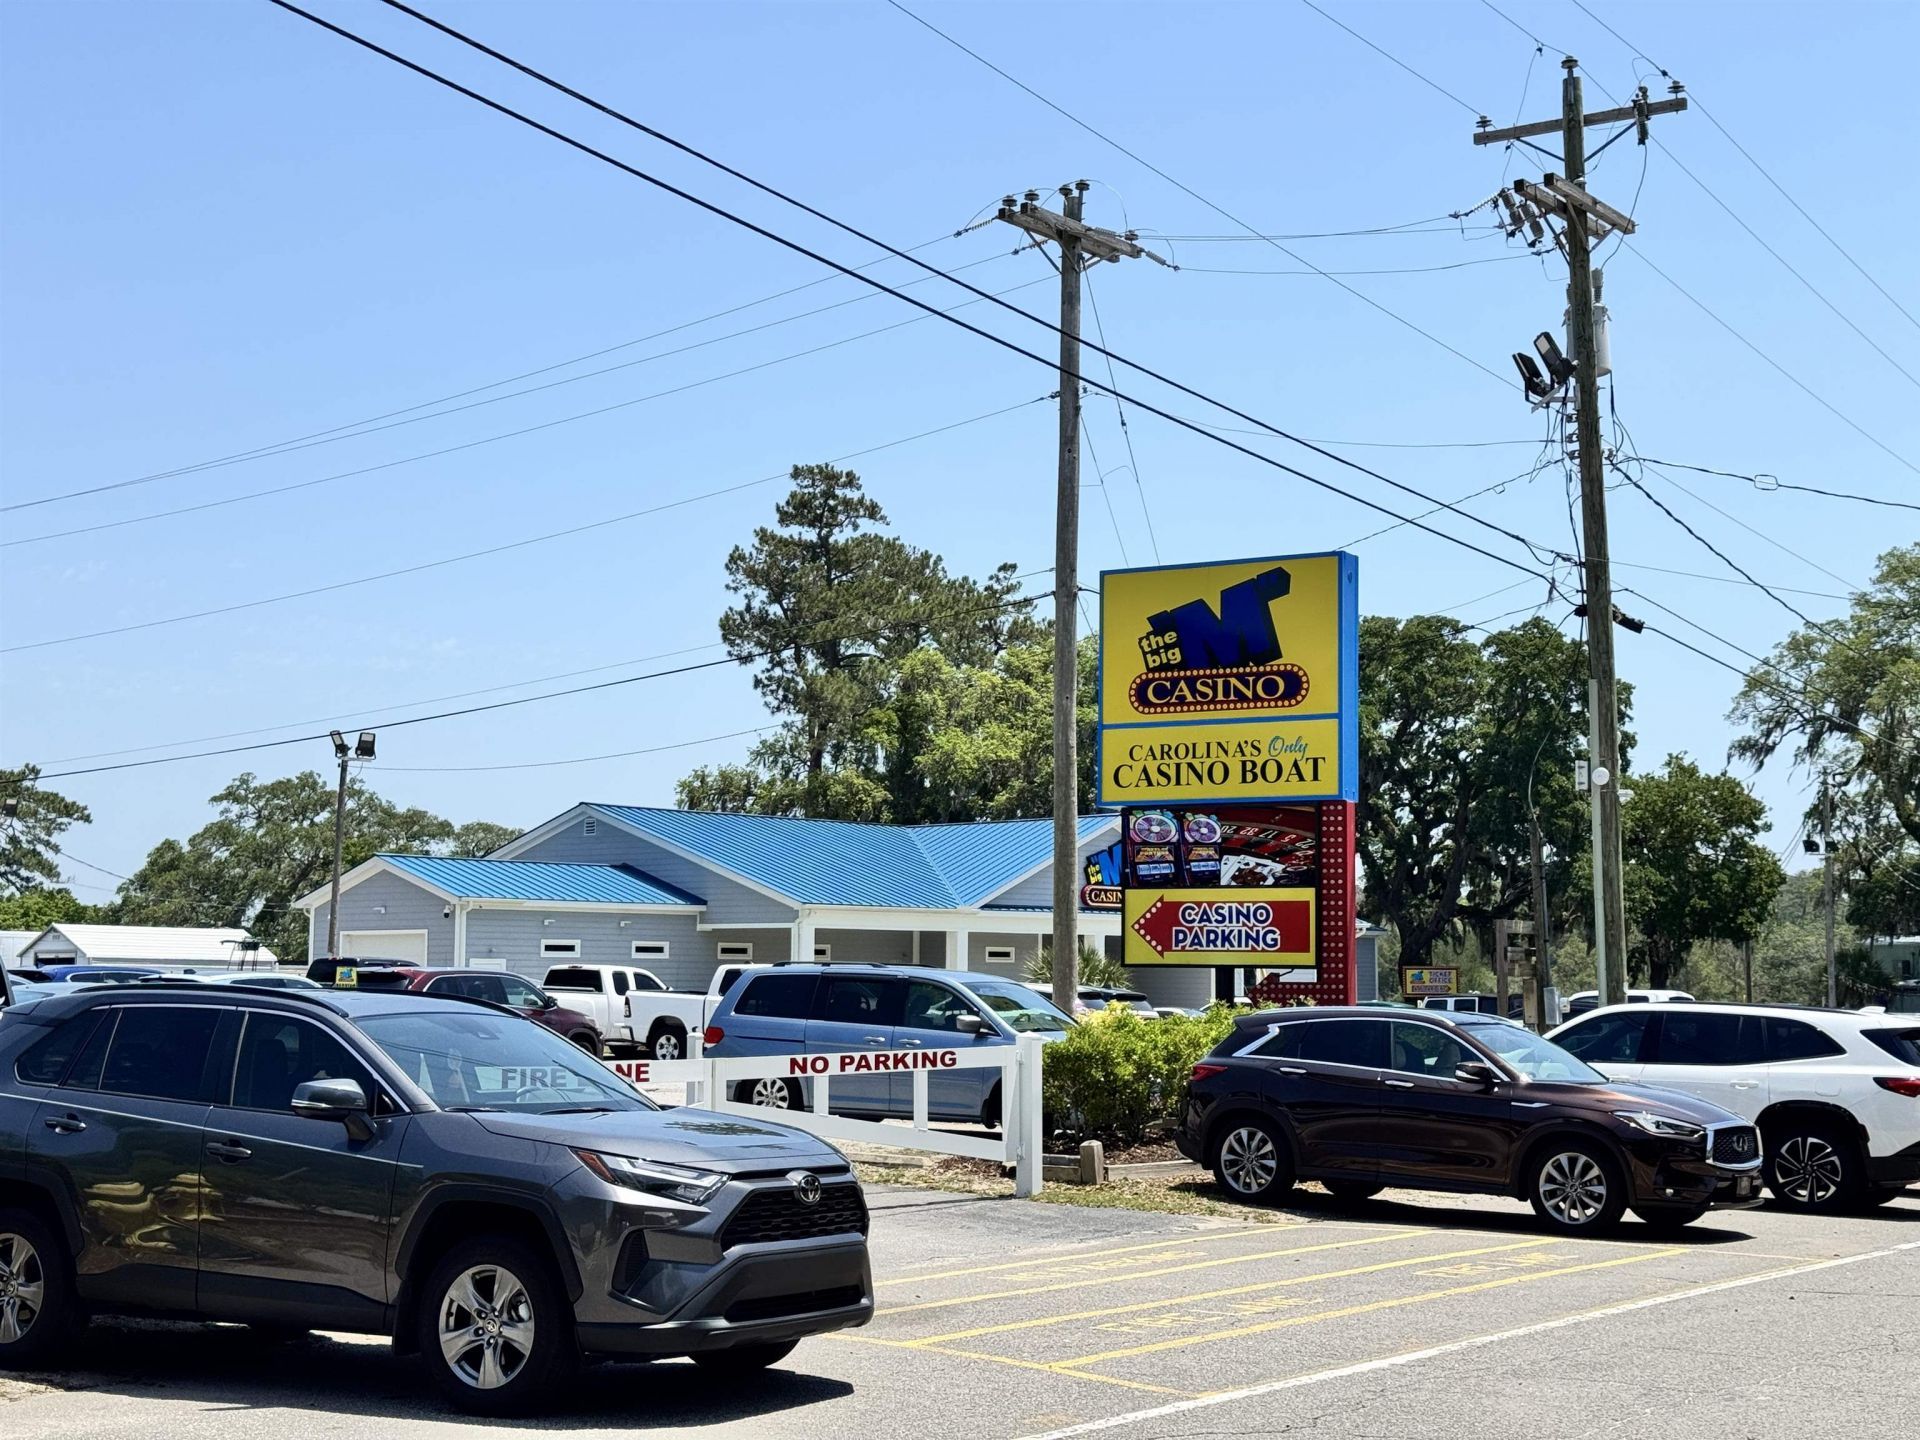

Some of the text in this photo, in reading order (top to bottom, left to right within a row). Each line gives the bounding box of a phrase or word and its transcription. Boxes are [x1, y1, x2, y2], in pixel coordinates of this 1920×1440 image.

[1140, 630, 1178, 653] the
[1146, 647, 1182, 670] big
[1147, 675, 1285, 705] CASINO
[1129, 735, 1308, 762] CAROLINA'S Only
[1113, 756, 1326, 788] CASINO BOAT
[1091, 890, 1122, 902] CASIN
[1179, 902, 1273, 928] CASINO
[1172, 926, 1280, 951] PARKING
[789, 1050, 957, 1075] NO PARKING
[502, 1067, 567, 1088] FIRE
